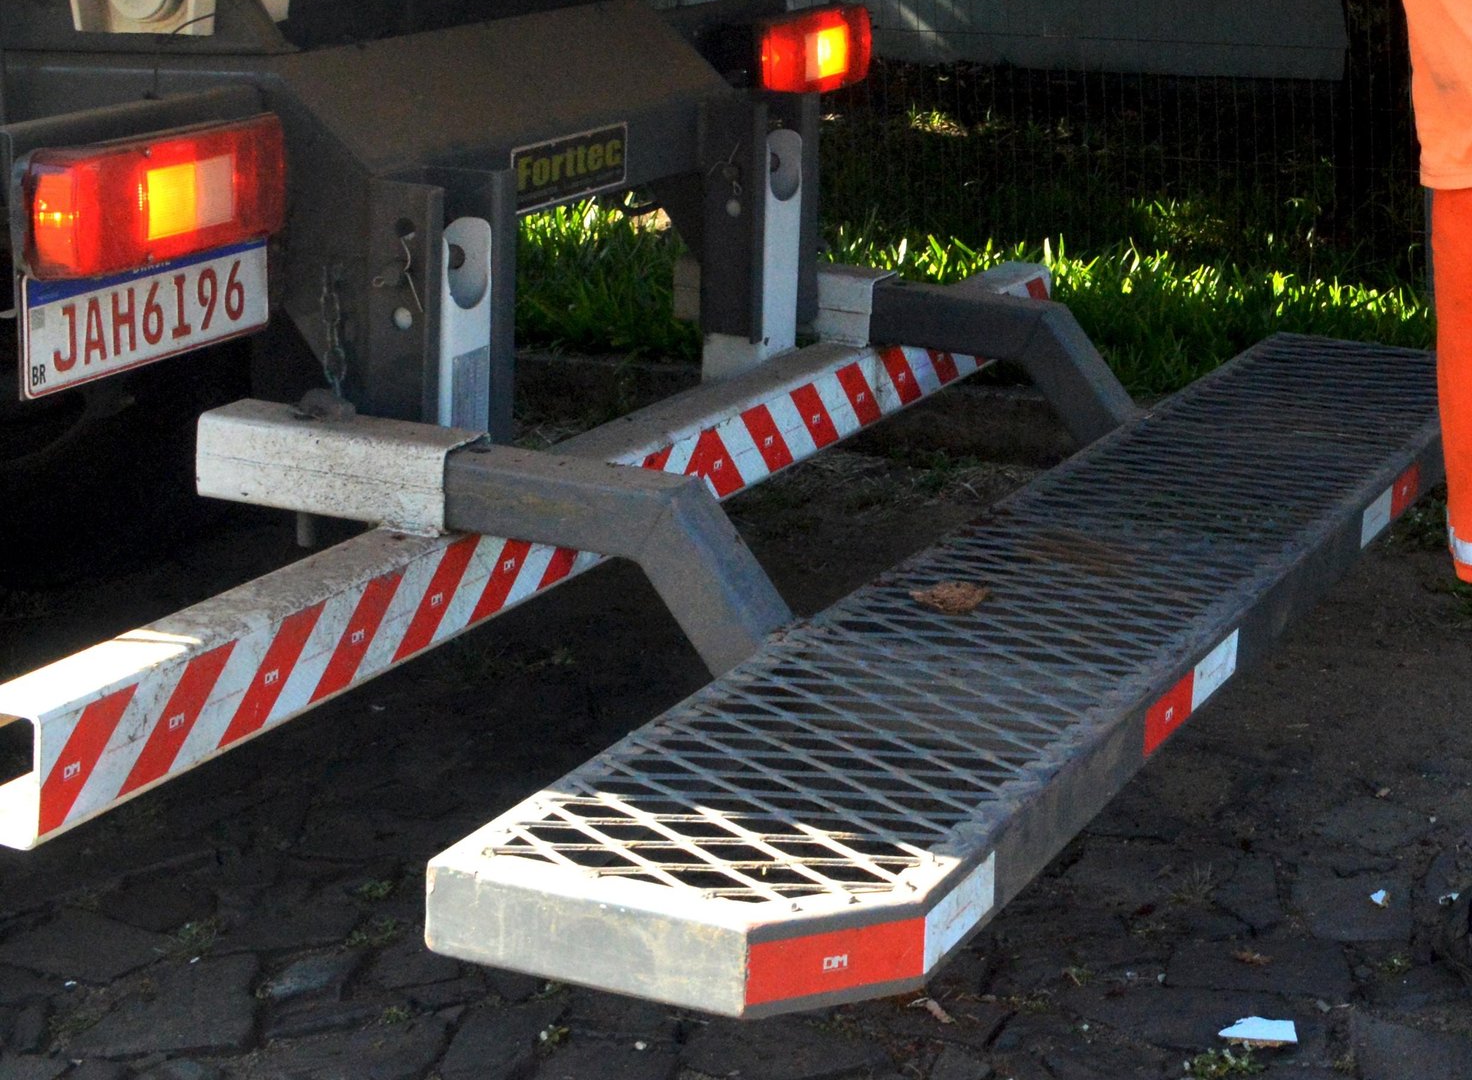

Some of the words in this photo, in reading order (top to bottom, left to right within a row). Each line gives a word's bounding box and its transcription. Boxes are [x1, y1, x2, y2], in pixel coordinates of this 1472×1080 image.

[32, 364, 46, 387] BR
[264, 668, 279, 684] DM
[169, 712, 185, 728] DM
[63, 761, 81, 778] DM
[823, 954, 848, 970] DM
